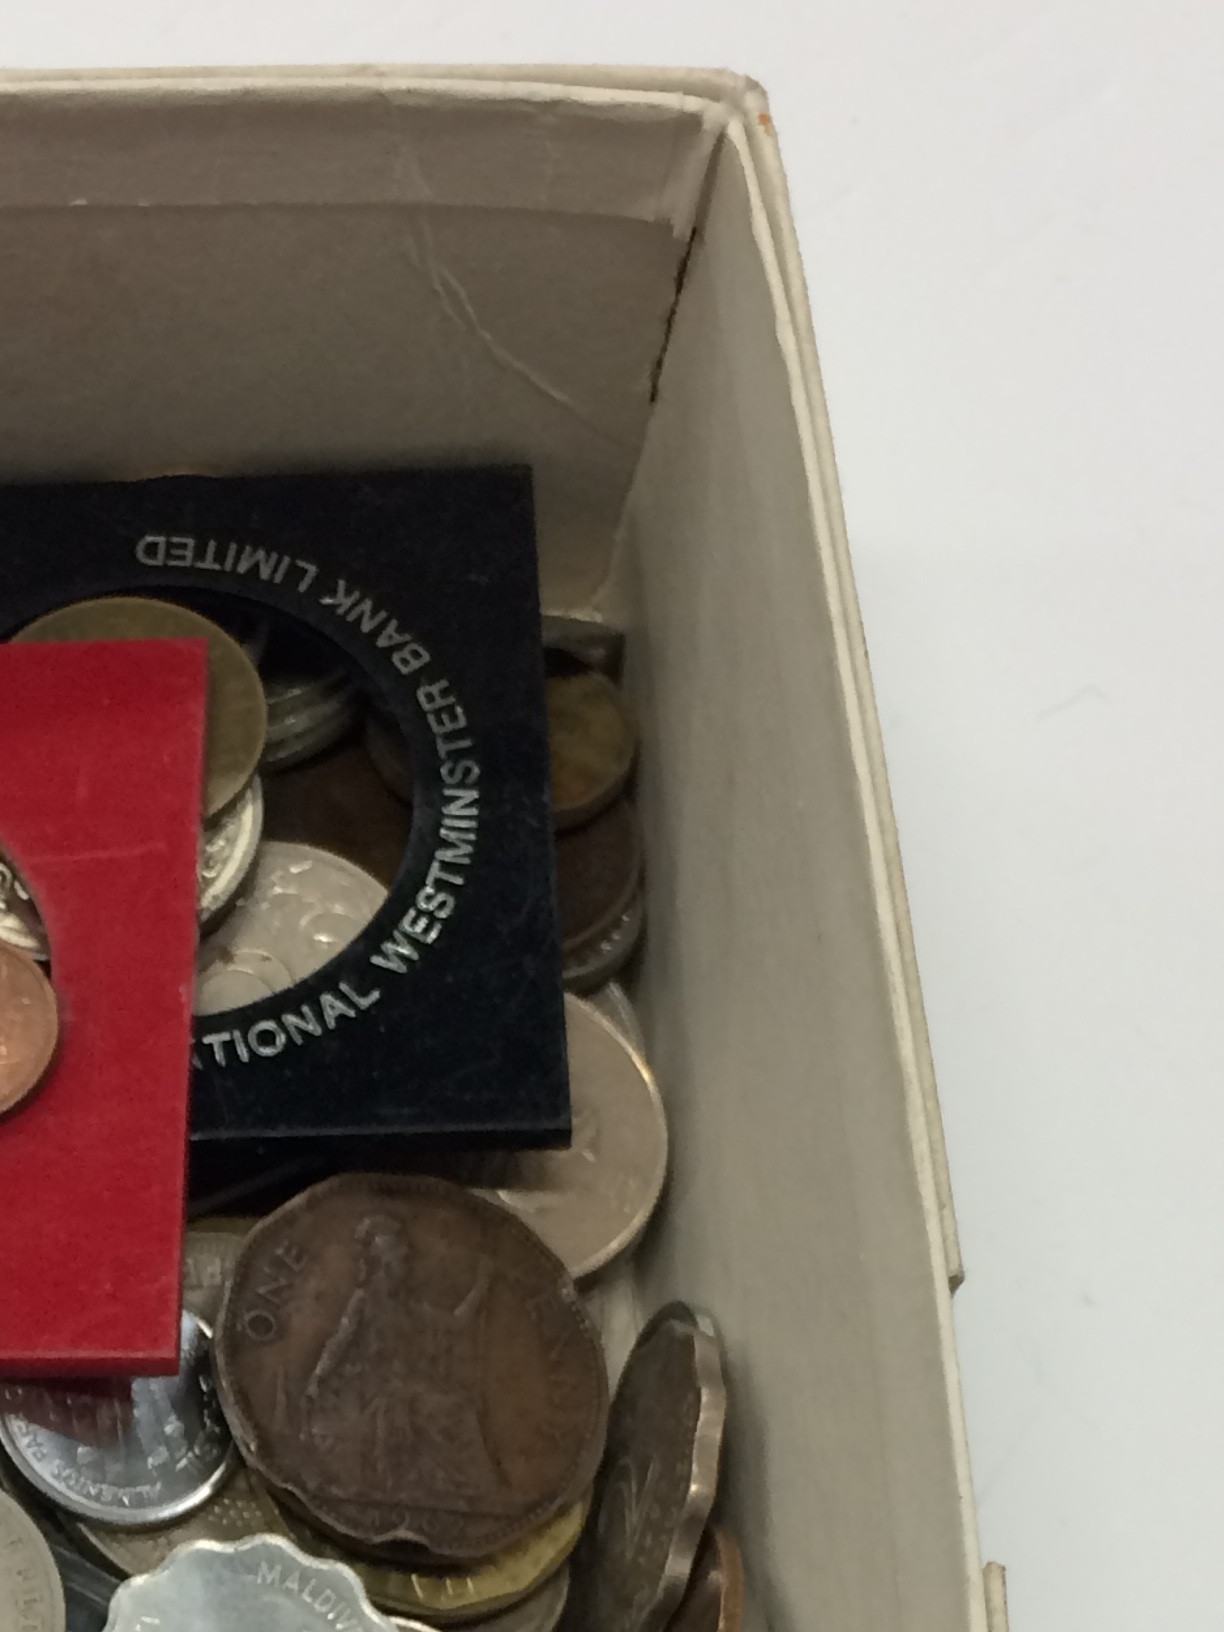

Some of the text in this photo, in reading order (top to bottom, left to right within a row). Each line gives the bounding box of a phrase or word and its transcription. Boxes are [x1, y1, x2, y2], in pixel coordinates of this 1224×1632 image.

[135, 532, 479, 1069] TIONAL WESTMINSTER BANK LIMITED
[240, 1240, 310, 1342] ONE
